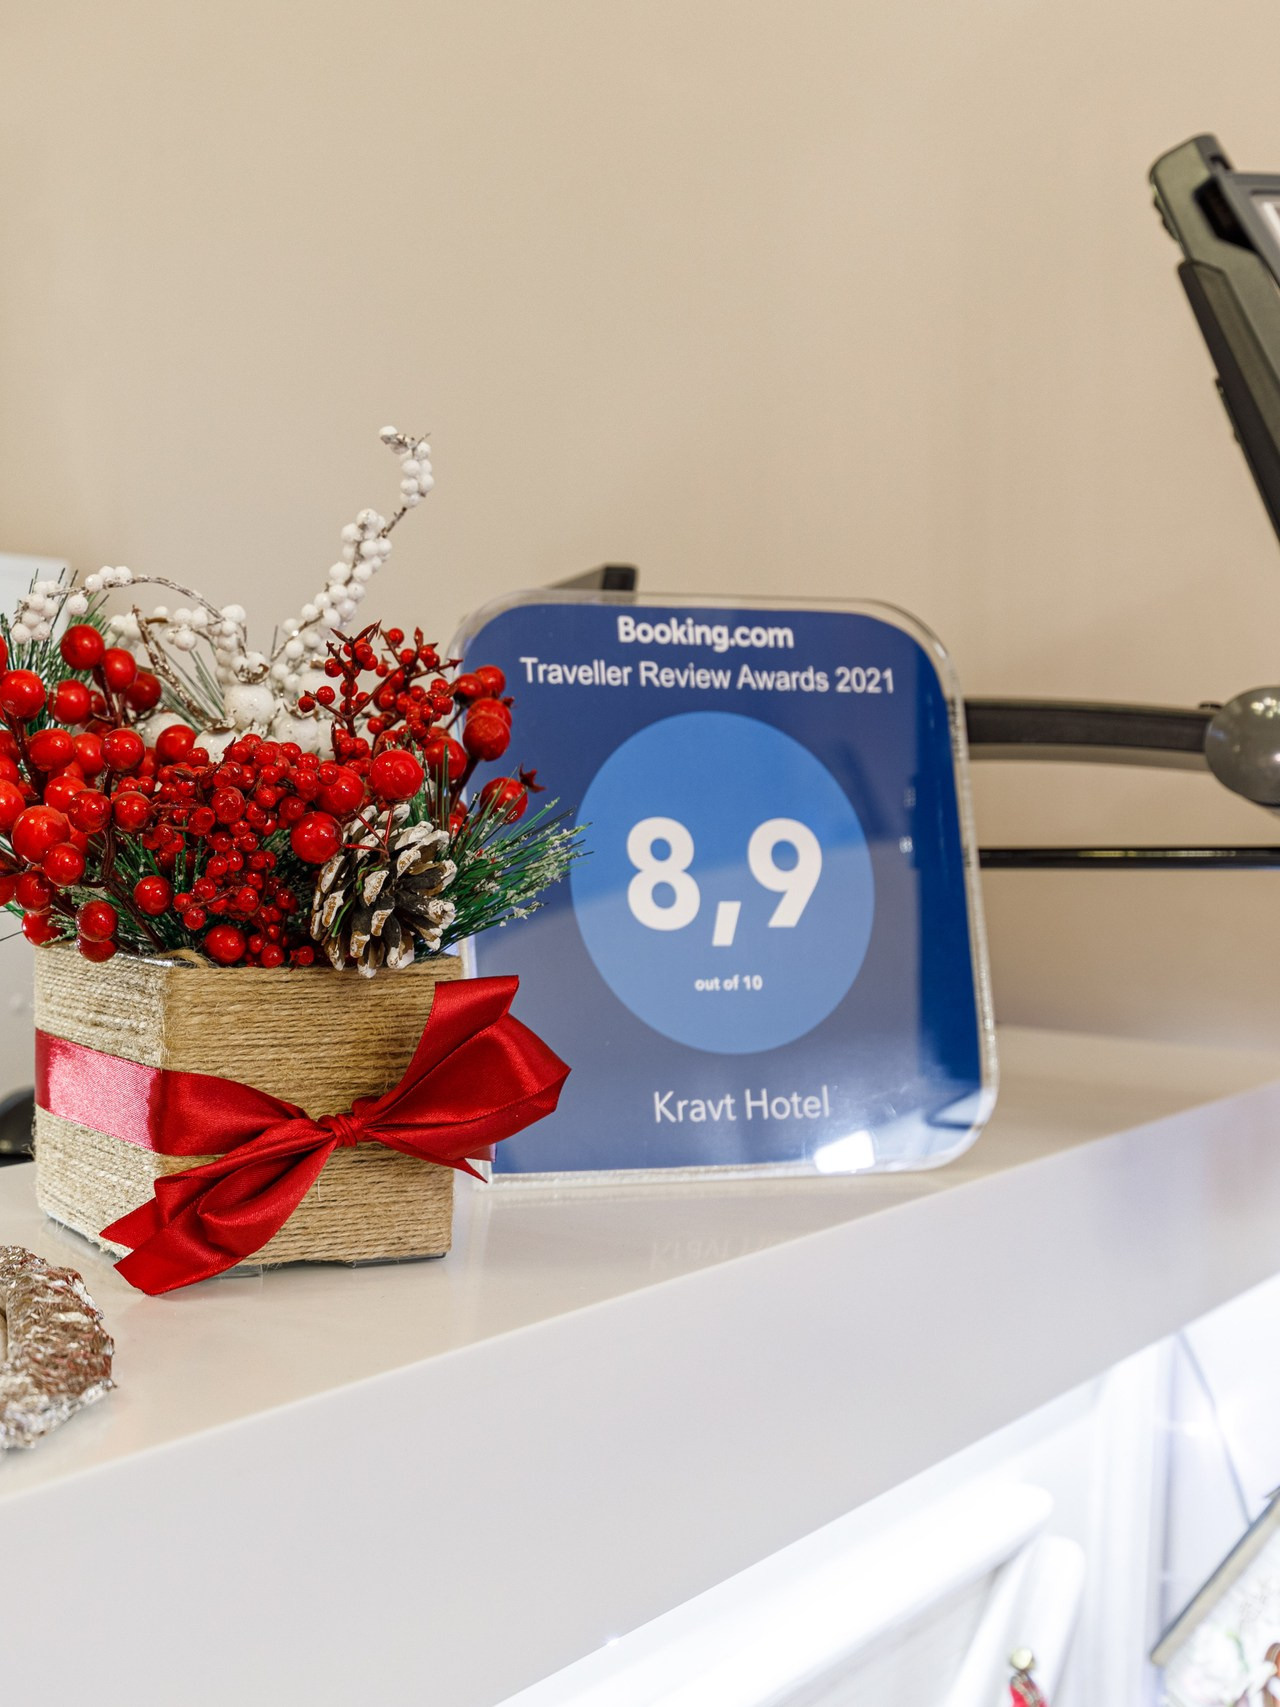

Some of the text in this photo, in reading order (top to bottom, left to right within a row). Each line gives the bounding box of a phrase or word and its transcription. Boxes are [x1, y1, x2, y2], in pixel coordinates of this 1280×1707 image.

[617, 615, 795, 652] Booking.com
[519, 656, 895, 694] Traveller Review Awards 2021
[626, 816, 822, 947] 8,9
[694, 974, 764, 992] out of 10
[653, 1084, 830, 1124] Kravt Hotel
